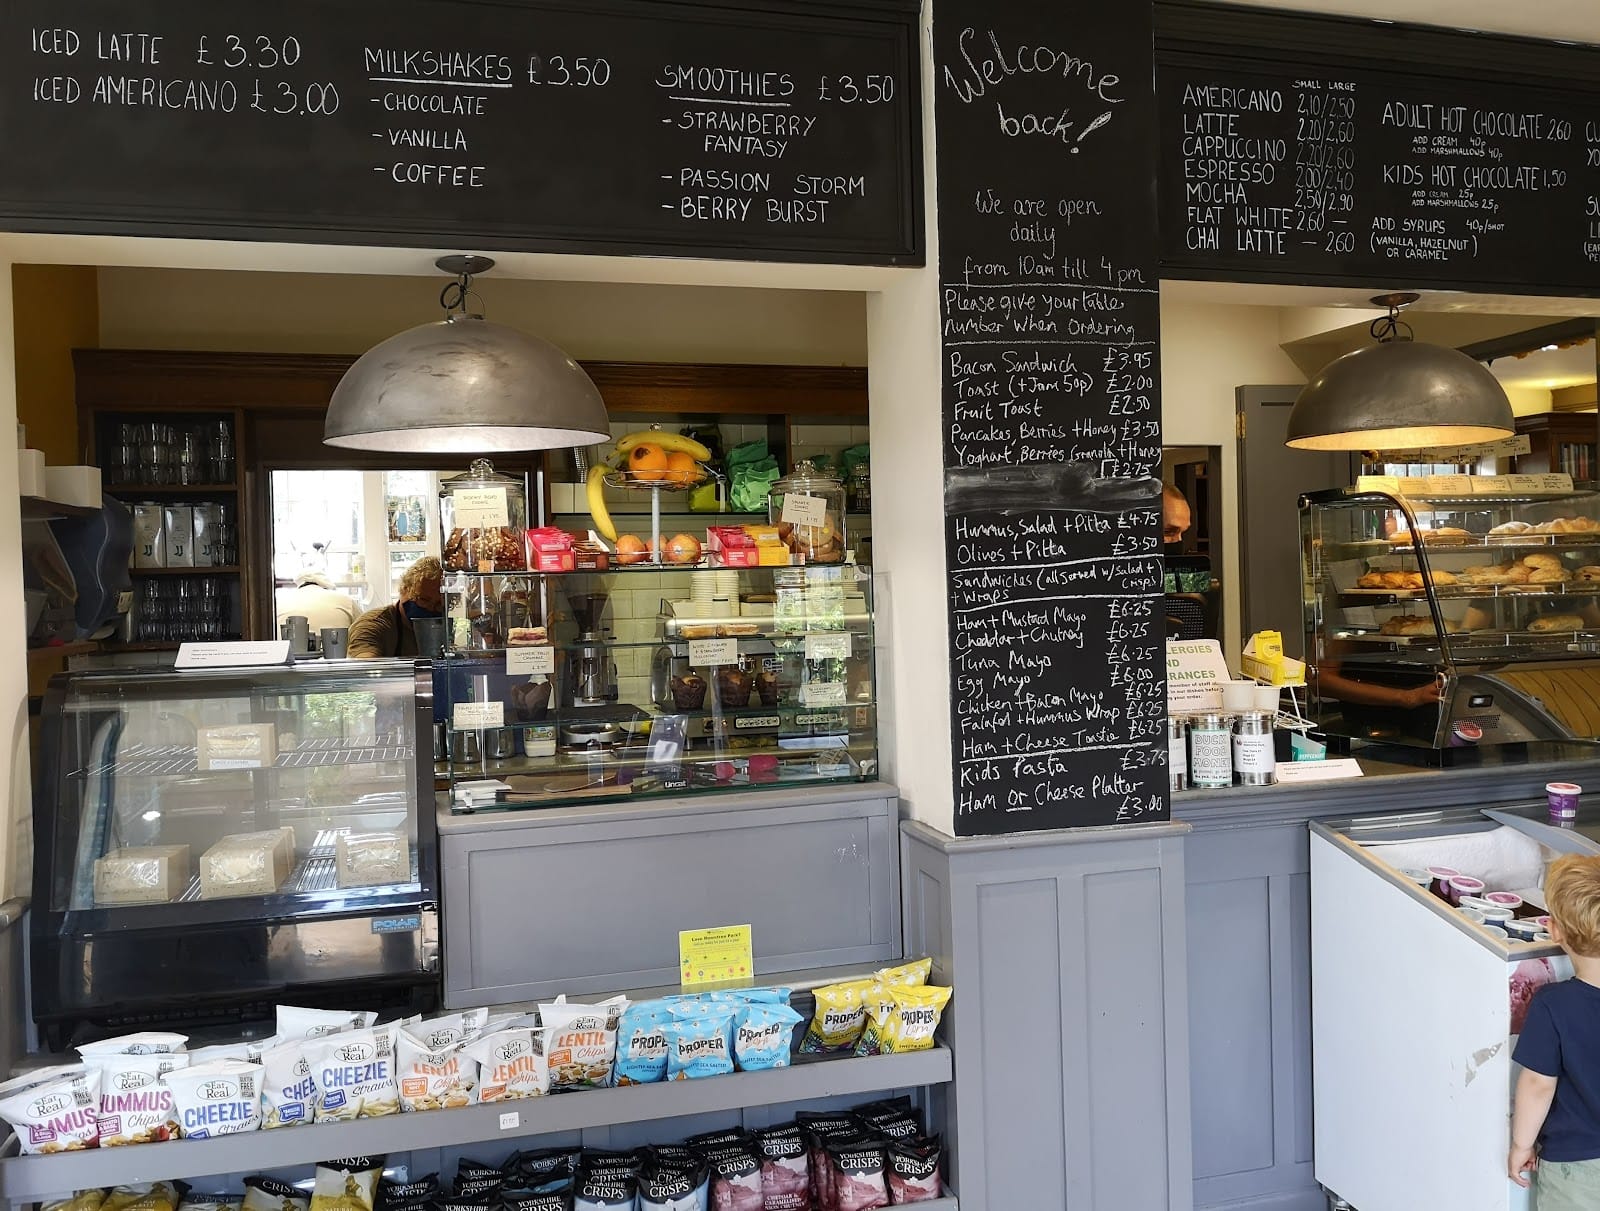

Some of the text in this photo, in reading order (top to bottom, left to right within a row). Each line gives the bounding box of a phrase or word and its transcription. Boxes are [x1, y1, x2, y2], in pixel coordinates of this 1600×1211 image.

[32, 28, 164, 65] ICED LATTE
[364, 47, 513, 81] MILKSHAKES
[944, 26, 1126, 104] Welcome
[655, 64, 795, 98] SMOOTHIES
[1291, 79, 1357, 92] SMALL LARGE
[33, 76, 238, 113] ICED AMERICANO
[1182, 83, 1283, 113] AMERICANO
[677, 111, 817, 137] STRAWBERRY
[1183, 112, 1240, 136] LATTE
[1382, 101, 1544, 140] ADULT HOT CHOCOLATE
[703, 135, 789, 159] FANTASY
[1182, 135, 1287, 162] CAPPUCCINO
[1412, 135, 1487, 151] ADD CREAM 40p
[679, 168, 865, 197] PASSION STORM
[1184, 158, 1276, 185] ESPRESSO
[1383, 164, 1541, 191] KIDS HOT CHOCOLATE
[1185, 181, 1248, 205] MOCHA
[680, 196, 831, 224] BERRY BURST
[975, 188, 1102, 226] We are open
[1187, 206, 1294, 230] FLAT WHITE
[1371, 216, 1446, 235] ADD SYRUPS
[1010, 221, 1057, 261] daily
[1186, 226, 1288, 255] CHAI LATTE
[1386, 247, 1450, 262] OR CARAMEL
[963, 255, 1010, 291] from
[1061, 256, 1089, 279] till
[944, 289, 1126, 320] Please give your table
[950, 347, 1153, 377] Bacon Sandwich £3.95
[953, 378, 1000, 399] Toast
[1106, 373, 1154, 394] £2.00
[954, 394, 1151, 421] Fruit Toast £2.50
[1019, 418, 1160, 441] Berries £3.50
[1018, 511, 1160, 536] Salad £4.75
[957, 533, 1158, 565] Olives £3.50
[953, 571, 1033, 590] Sandwiches
[1002, 599, 1155, 631] Mustard Mayo £6.25
[1105, 620, 1151, 643] £6.25
[956, 644, 1158, 677] Tuna Mayo £6.25
[1167, 645, 1213, 655] ERGIES
[957, 664, 1153, 699] Egg Mayo £6.00
[1167, 670, 1217, 681] RANCES
[957, 693, 1013, 716] Chicken
[1069, 687, 1104, 708] Mayo
[1125, 680, 1166, 701] £6.25
[1085, 702, 1121, 726] Wrap
[1125, 700, 1165, 721] £6.25
[1127, 717, 1167, 741] £6.25
[960, 761, 1001, 788] Kids
[1119, 749, 1169, 772] £3.75
[959, 773, 1145, 816] Ham Cheese Platter
[1115, 794, 1163, 821] £3.00
[575, 1021, 598, 1031] Real
[824, 1006, 865, 1025] PROPER
[557, 1031, 606, 1048] LENTIL
[678, 1037, 724, 1056] PROPER
[342, 1049, 368, 1062] Real
[502, 1046, 525, 1061] Real
[577, 1047, 607, 1059] Chips
[126, 1071, 141, 1082] Eat
[321, 1060, 388, 1090] CHEEZIE
[491, 1055, 537, 1083] LENTIL
[120, 1076, 146, 1090] Real
[205, 1086, 232, 1099] Real
[208, 1081, 226, 1091] Eat
[184, 1101, 254, 1129] CHEEZIE
[763, 1143, 803, 1156] CRISPS
[839, 1150, 881, 1160] YORKSHIRE
[718, 1158, 757, 1175] CRISPS
[840, 1157, 882, 1170] CRISPS
[894, 1161, 935, 1175] CRISPS
[583, 1185, 626, 1200] CRISPS
[649, 1180, 690, 1198] CRISPS
